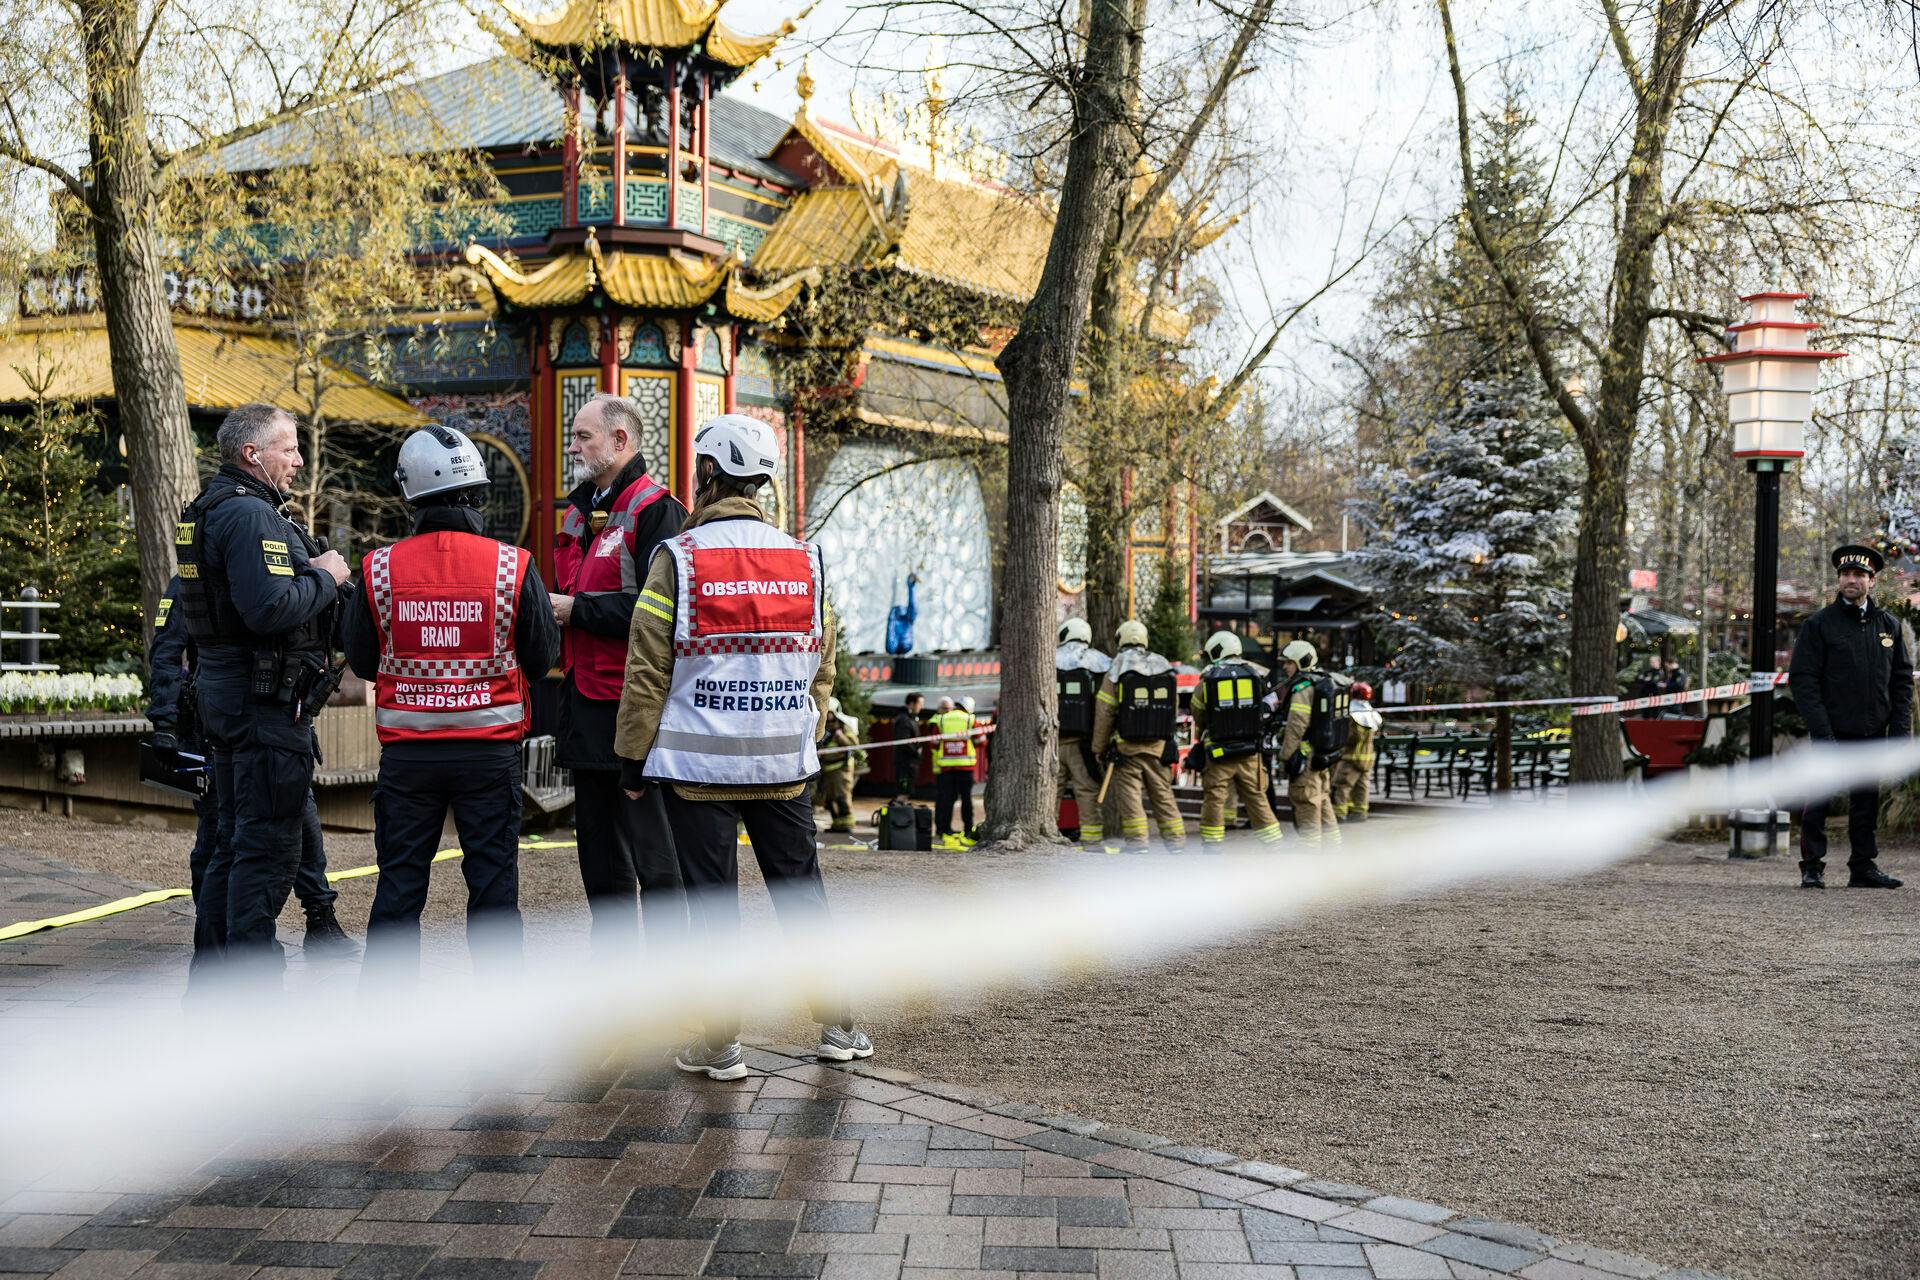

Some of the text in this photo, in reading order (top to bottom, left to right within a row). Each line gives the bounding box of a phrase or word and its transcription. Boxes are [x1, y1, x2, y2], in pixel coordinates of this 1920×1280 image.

[450, 456, 462, 464] RES
[264, 543, 287, 551] POLITI
[272, 555, 282, 565] 11
[1839, 554, 1870, 565] TIVOLI
[702, 580, 808, 596] OBSERVATØR
[398, 601, 482, 622] INDSATSLEDER
[421, 626, 460, 647] BRAND
[396, 681, 490, 693] HOVEDSTADENS
[695, 678, 807, 693] HOVEDSTADENS
[395, 692, 491, 707] BEREDSKAB
[694, 692, 805, 711] BEREDSKAB
